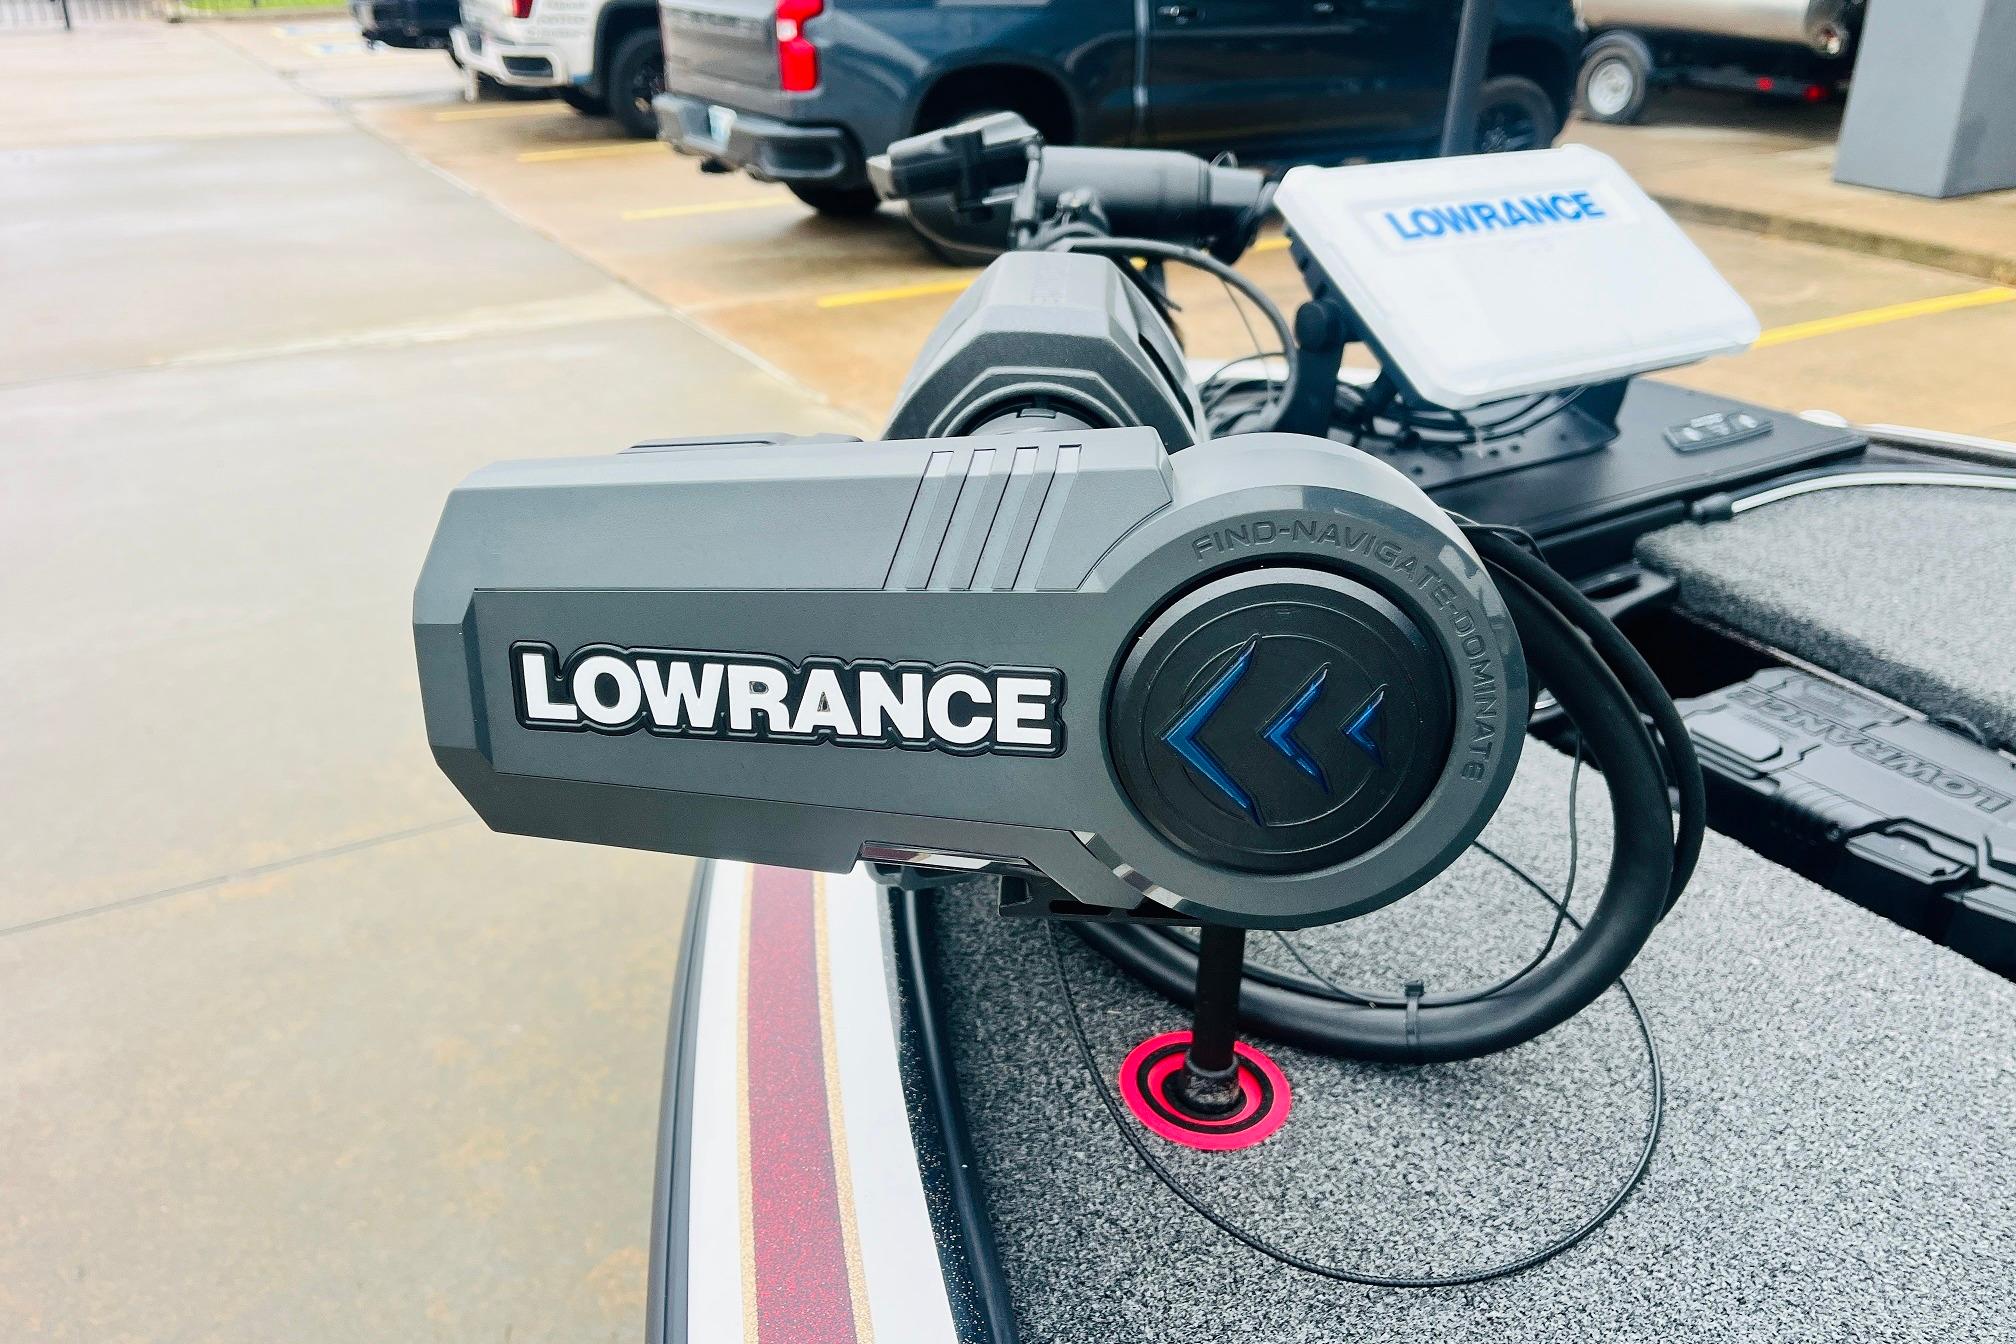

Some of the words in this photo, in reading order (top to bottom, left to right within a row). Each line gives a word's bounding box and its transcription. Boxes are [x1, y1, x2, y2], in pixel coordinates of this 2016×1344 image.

[1384, 191, 1606, 240] LOWRANCE
[519, 652, 1052, 745] LOWRANCE
[1727, 686, 2012, 814] LOWRANCE
